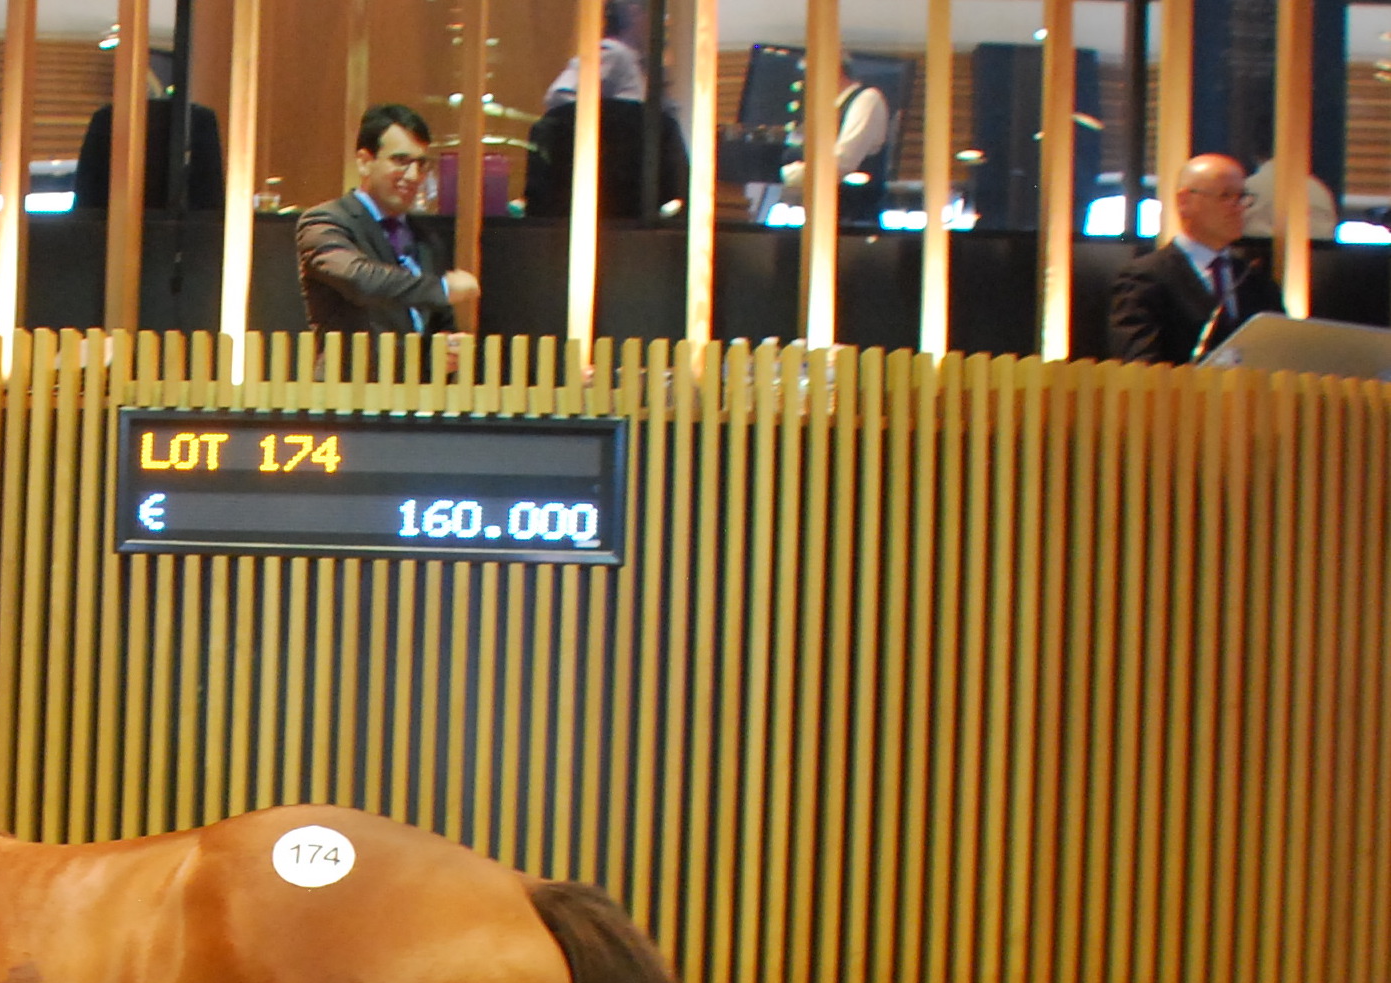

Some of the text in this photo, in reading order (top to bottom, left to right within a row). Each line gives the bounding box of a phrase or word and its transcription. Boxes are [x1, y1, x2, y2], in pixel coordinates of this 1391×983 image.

[140, 431, 342, 473] LOT 174
[139, 492, 599, 542] € 160.000
[290, 843, 341, 867] 174
